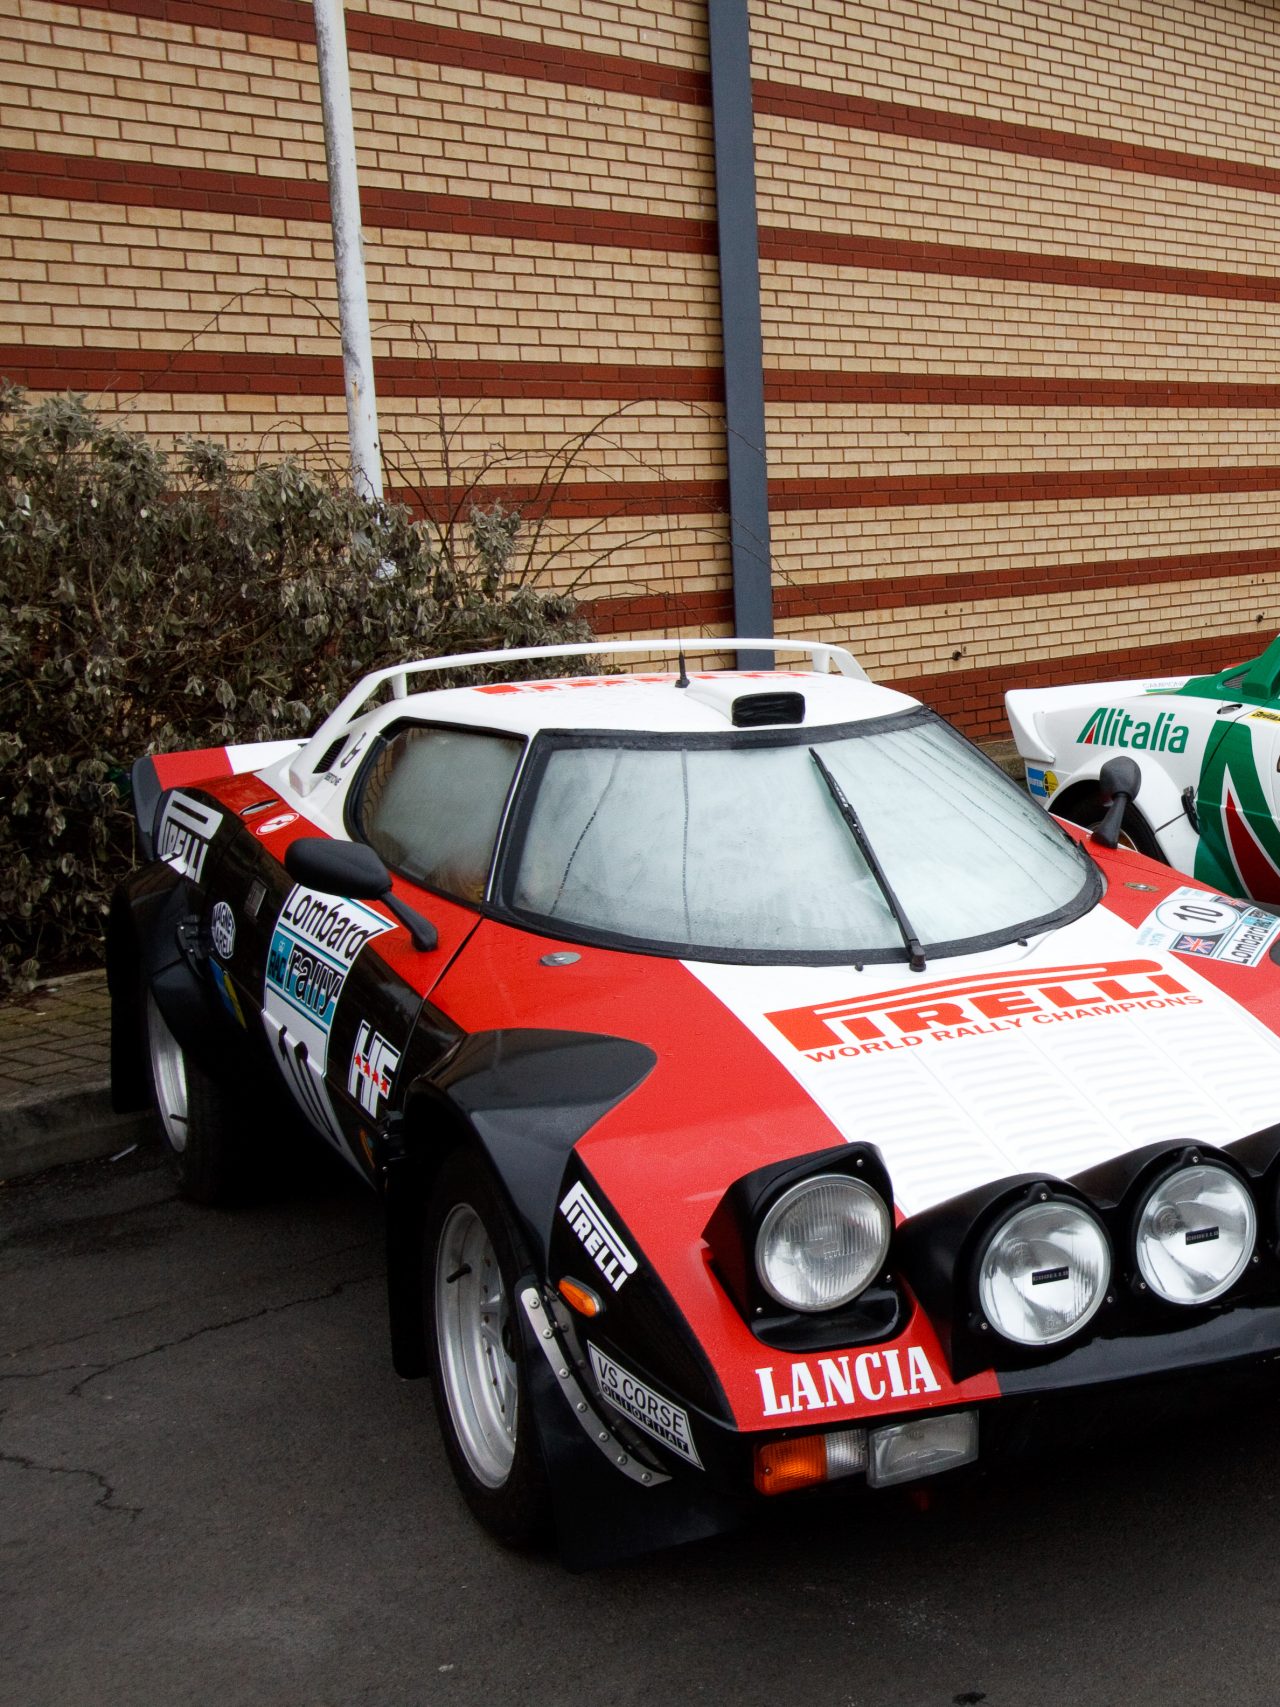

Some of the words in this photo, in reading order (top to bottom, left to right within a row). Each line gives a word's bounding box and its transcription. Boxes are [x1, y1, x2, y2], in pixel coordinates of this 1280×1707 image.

[1076, 707, 1190, 753] Alitalia
[157, 789, 224, 884] PIRELLI
[281, 882, 385, 961] Lombard
[1172, 904, 1224, 924] 10
[1219, 923, 1270, 965] Lombard
[284, 949, 344, 1017] rally
[763, 958, 1192, 1052] PIRELLI
[803, 1034, 924, 1064] WORLD
[931, 1018, 1025, 1043] RALLY
[1032, 995, 1204, 1025] CHAMPIONS
[347, 1018, 402, 1120] HF
[559, 1180, 639, 1293] PIRELLI
[597, 1356, 619, 1389] VS
[622, 1378, 684, 1438] CORSE
[755, 1346, 941, 1417] LANCIA
